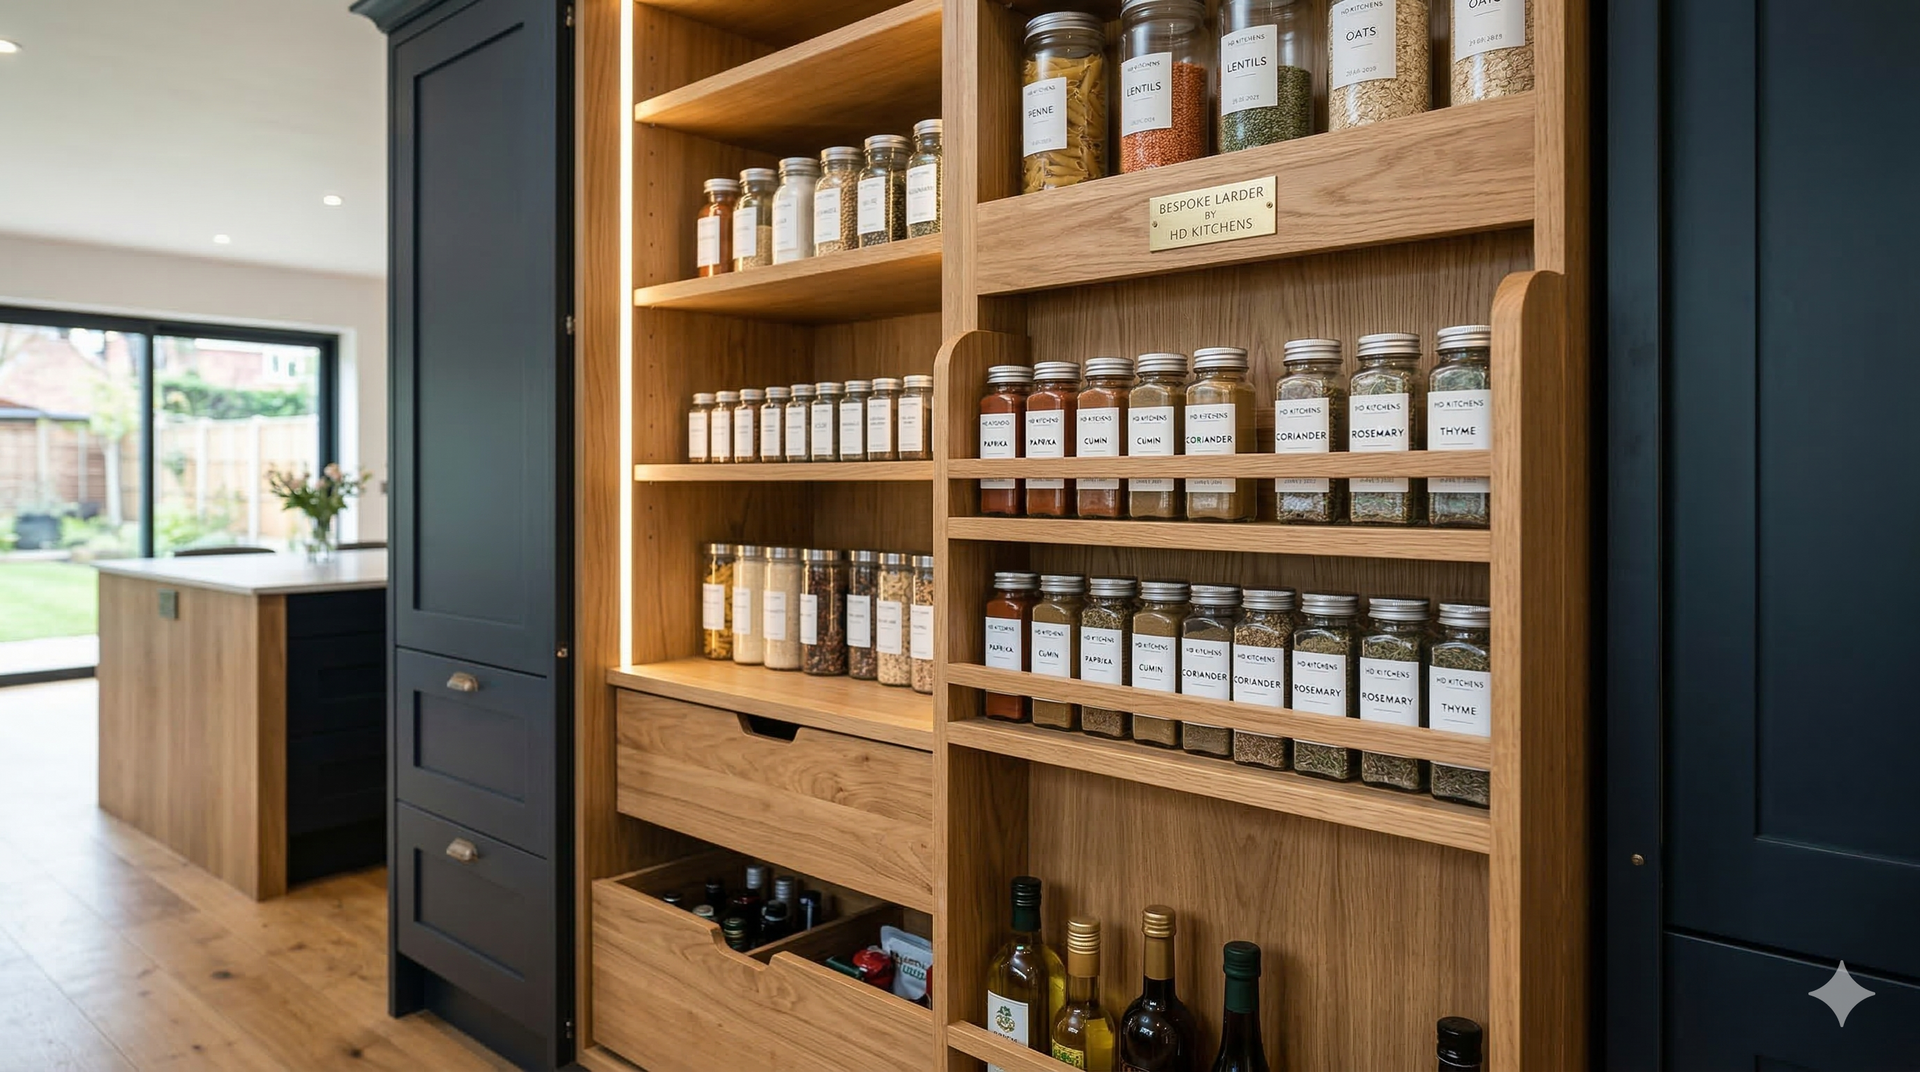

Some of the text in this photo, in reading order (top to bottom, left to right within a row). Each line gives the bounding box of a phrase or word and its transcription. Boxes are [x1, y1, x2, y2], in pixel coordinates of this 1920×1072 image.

[1350, 1, 1384, 12] KITCHENS
[1235, 33, 1266, 45] KITCHENS
[1346, 26, 1377, 42] OATS
[1227, 56, 1267, 73] LENTILS
[1126, 81, 1162, 98] LENTILS
[1028, 105, 1054, 119] PENNE
[1159, 186, 1264, 215] BESPOKE LARDER
[1204, 210, 1217, 220] BY
[1170, 217, 1253, 241] HD KITCHENS
[1446, 399, 1484, 408] KITCHENS
[1276, 431, 1327, 441] CORIANDER
[1351, 428, 1405, 439] ROSEMARY
[1440, 426, 1477, 436] THYME
[1084, 437, 1108, 445] CUMIN
[1136, 436, 1161, 445] CUMIN
[1186, 435, 1233, 444] CORIANDER
[1038, 649, 1059, 659] CUMIN
[1246, 653, 1276, 663] KITCHENS
[1085, 655, 1113, 665] PAPRIKA
[1138, 663, 1163, 673] CUMIN
[1182, 668, 1228, 681] CORIANDER
[1376, 669, 1410, 679] KITCHENS
[1234, 675, 1281, 689] CORIANDER
[1448, 678, 1484, 689] KITCHENS
[1294, 683, 1342, 697] ROSEMARY
[1362, 691, 1414, 705] ROSEMARY
[1441, 703, 1477, 715] THYME
